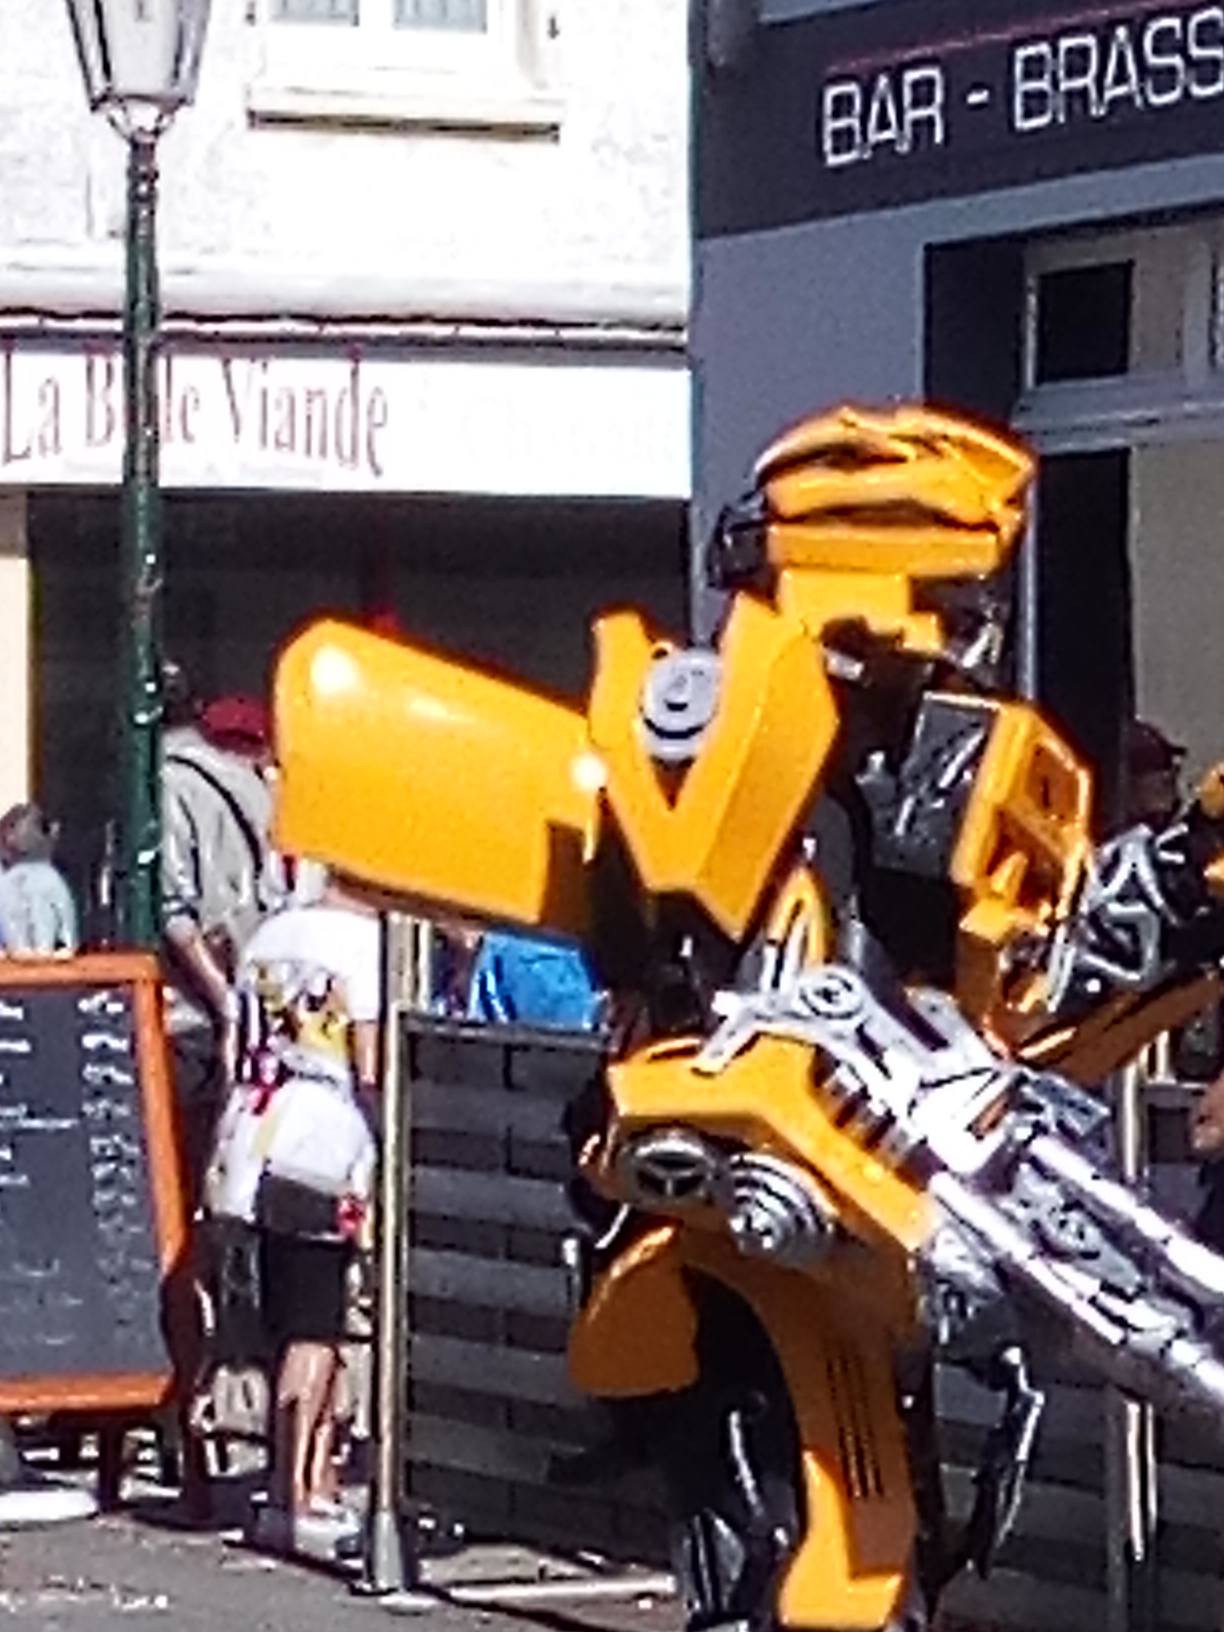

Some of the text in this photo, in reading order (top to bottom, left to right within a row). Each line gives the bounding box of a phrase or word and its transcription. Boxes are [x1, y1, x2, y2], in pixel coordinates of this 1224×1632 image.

[822, 65, 945, 167] BAR
[1, 342, 62, 467] La
[83, 342, 201, 446] Ble
[220, 344, 388, 478] Viande
